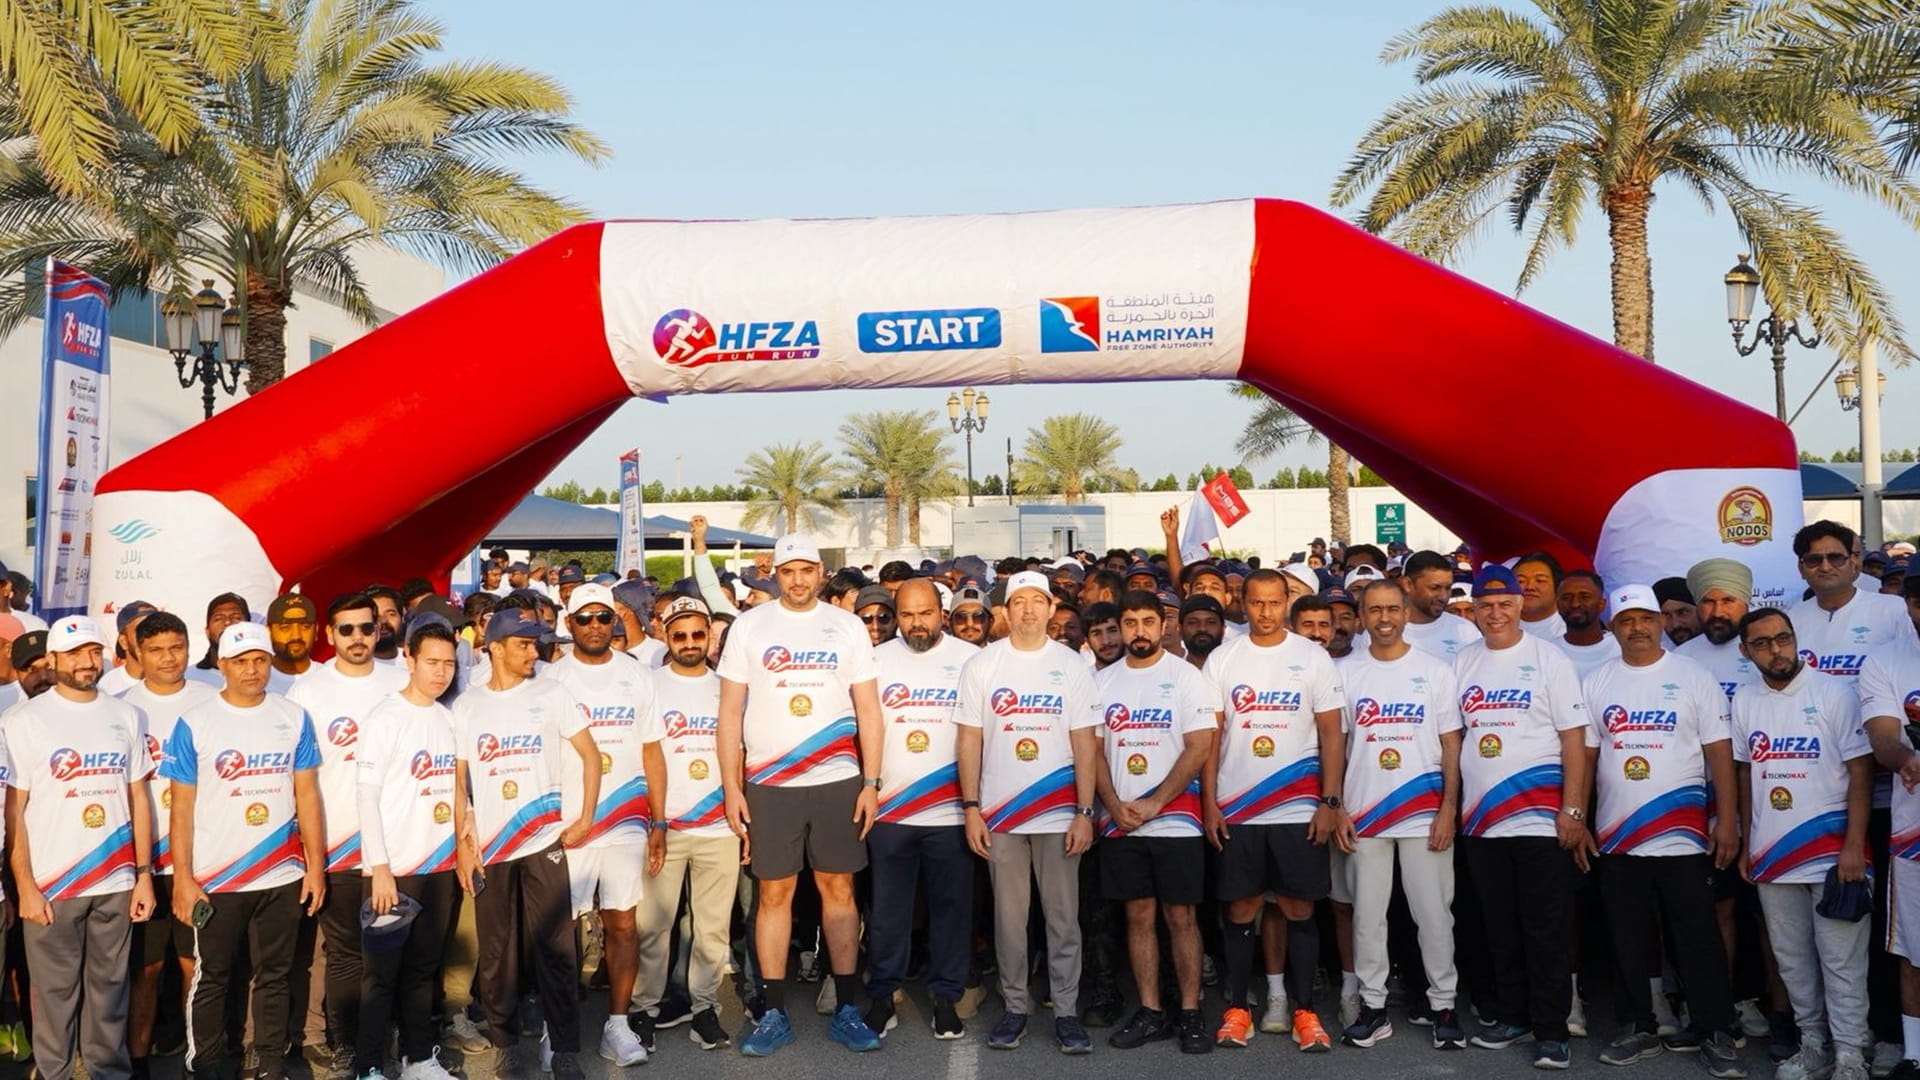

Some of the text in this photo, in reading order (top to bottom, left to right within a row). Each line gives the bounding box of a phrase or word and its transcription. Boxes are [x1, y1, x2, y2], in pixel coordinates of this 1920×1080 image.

[77, 321, 101, 347] HFZA
[719, 320, 820, 350] HFZA
[875, 316, 984, 346] START
[1107, 327, 1213, 343] HAMRIYAH
[1133, 343, 1157, 351] ZONE
[1160, 342, 1213, 350] AUTHORITY
[717, 351, 811, 362] FUN RUN
[1727, 525, 1768, 538] NODOS
[115, 570, 152, 580] ZULAL
[792, 651, 838, 664] HFZA
[911, 688, 957, 700] HFZA
[1019, 694, 1062, 708] HFZA
[1258, 692, 1300, 705] HFZA
[1485, 690, 1531, 703] HFZA
[592, 706, 635, 720] HFZA
[1131, 709, 1172, 722] HFZA
[1381, 704, 1424, 718] HFZA
[1629, 710, 1677, 725] HFZA
[690, 716, 718, 728] HFZ
[501, 734, 542, 750] HFZA
[1772, 737, 1820, 752] HFZA
[434, 754, 456, 768] HFZ
